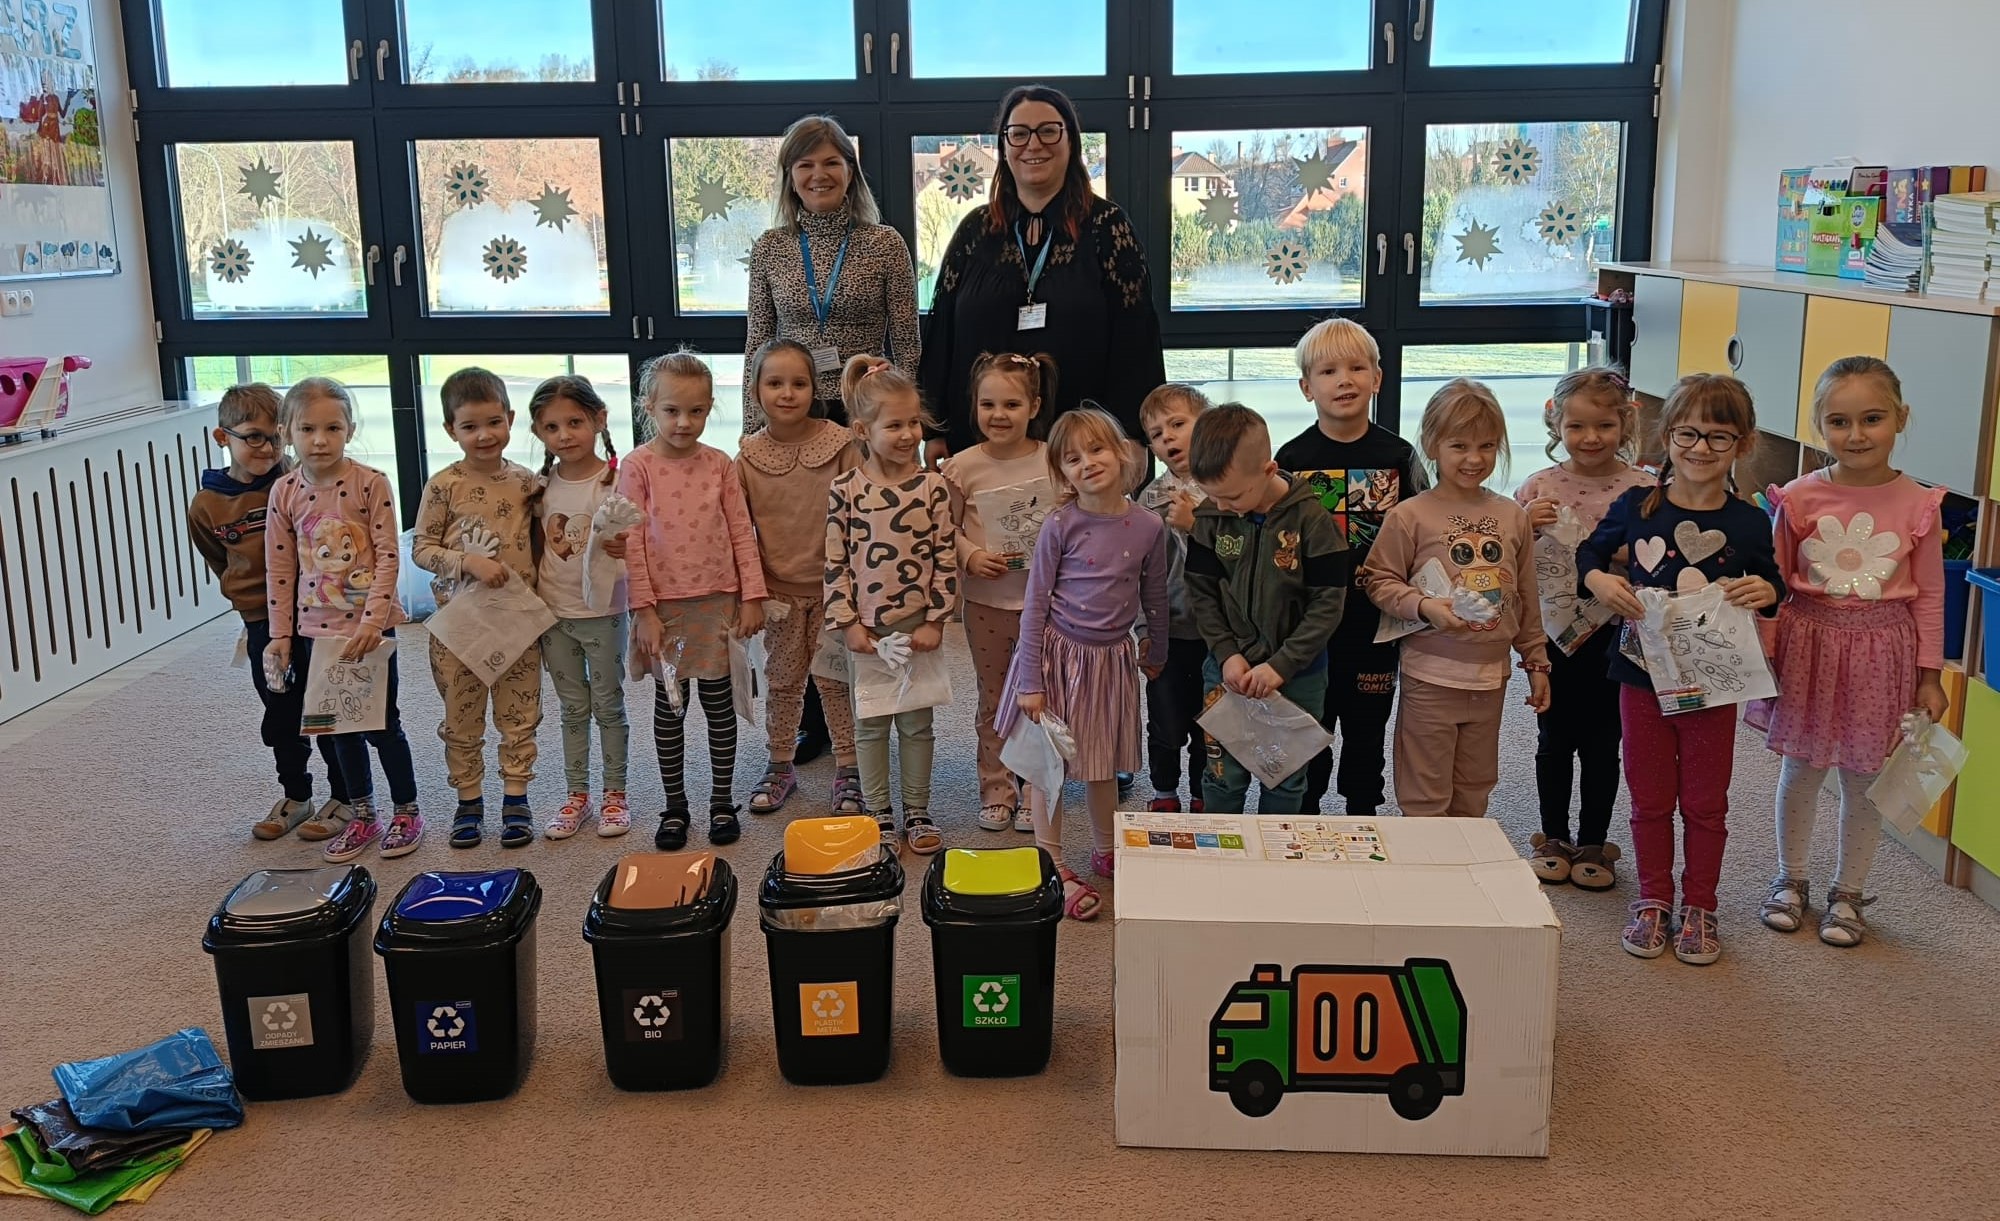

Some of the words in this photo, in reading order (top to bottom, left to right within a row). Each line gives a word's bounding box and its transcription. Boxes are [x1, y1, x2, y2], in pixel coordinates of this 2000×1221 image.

[975, 1016, 1008, 1025] SZKŁO
[265, 1031, 297, 1039] ODPADY
[644, 1030, 662, 1039] BIO
[430, 1041, 466, 1049] PAPIER
